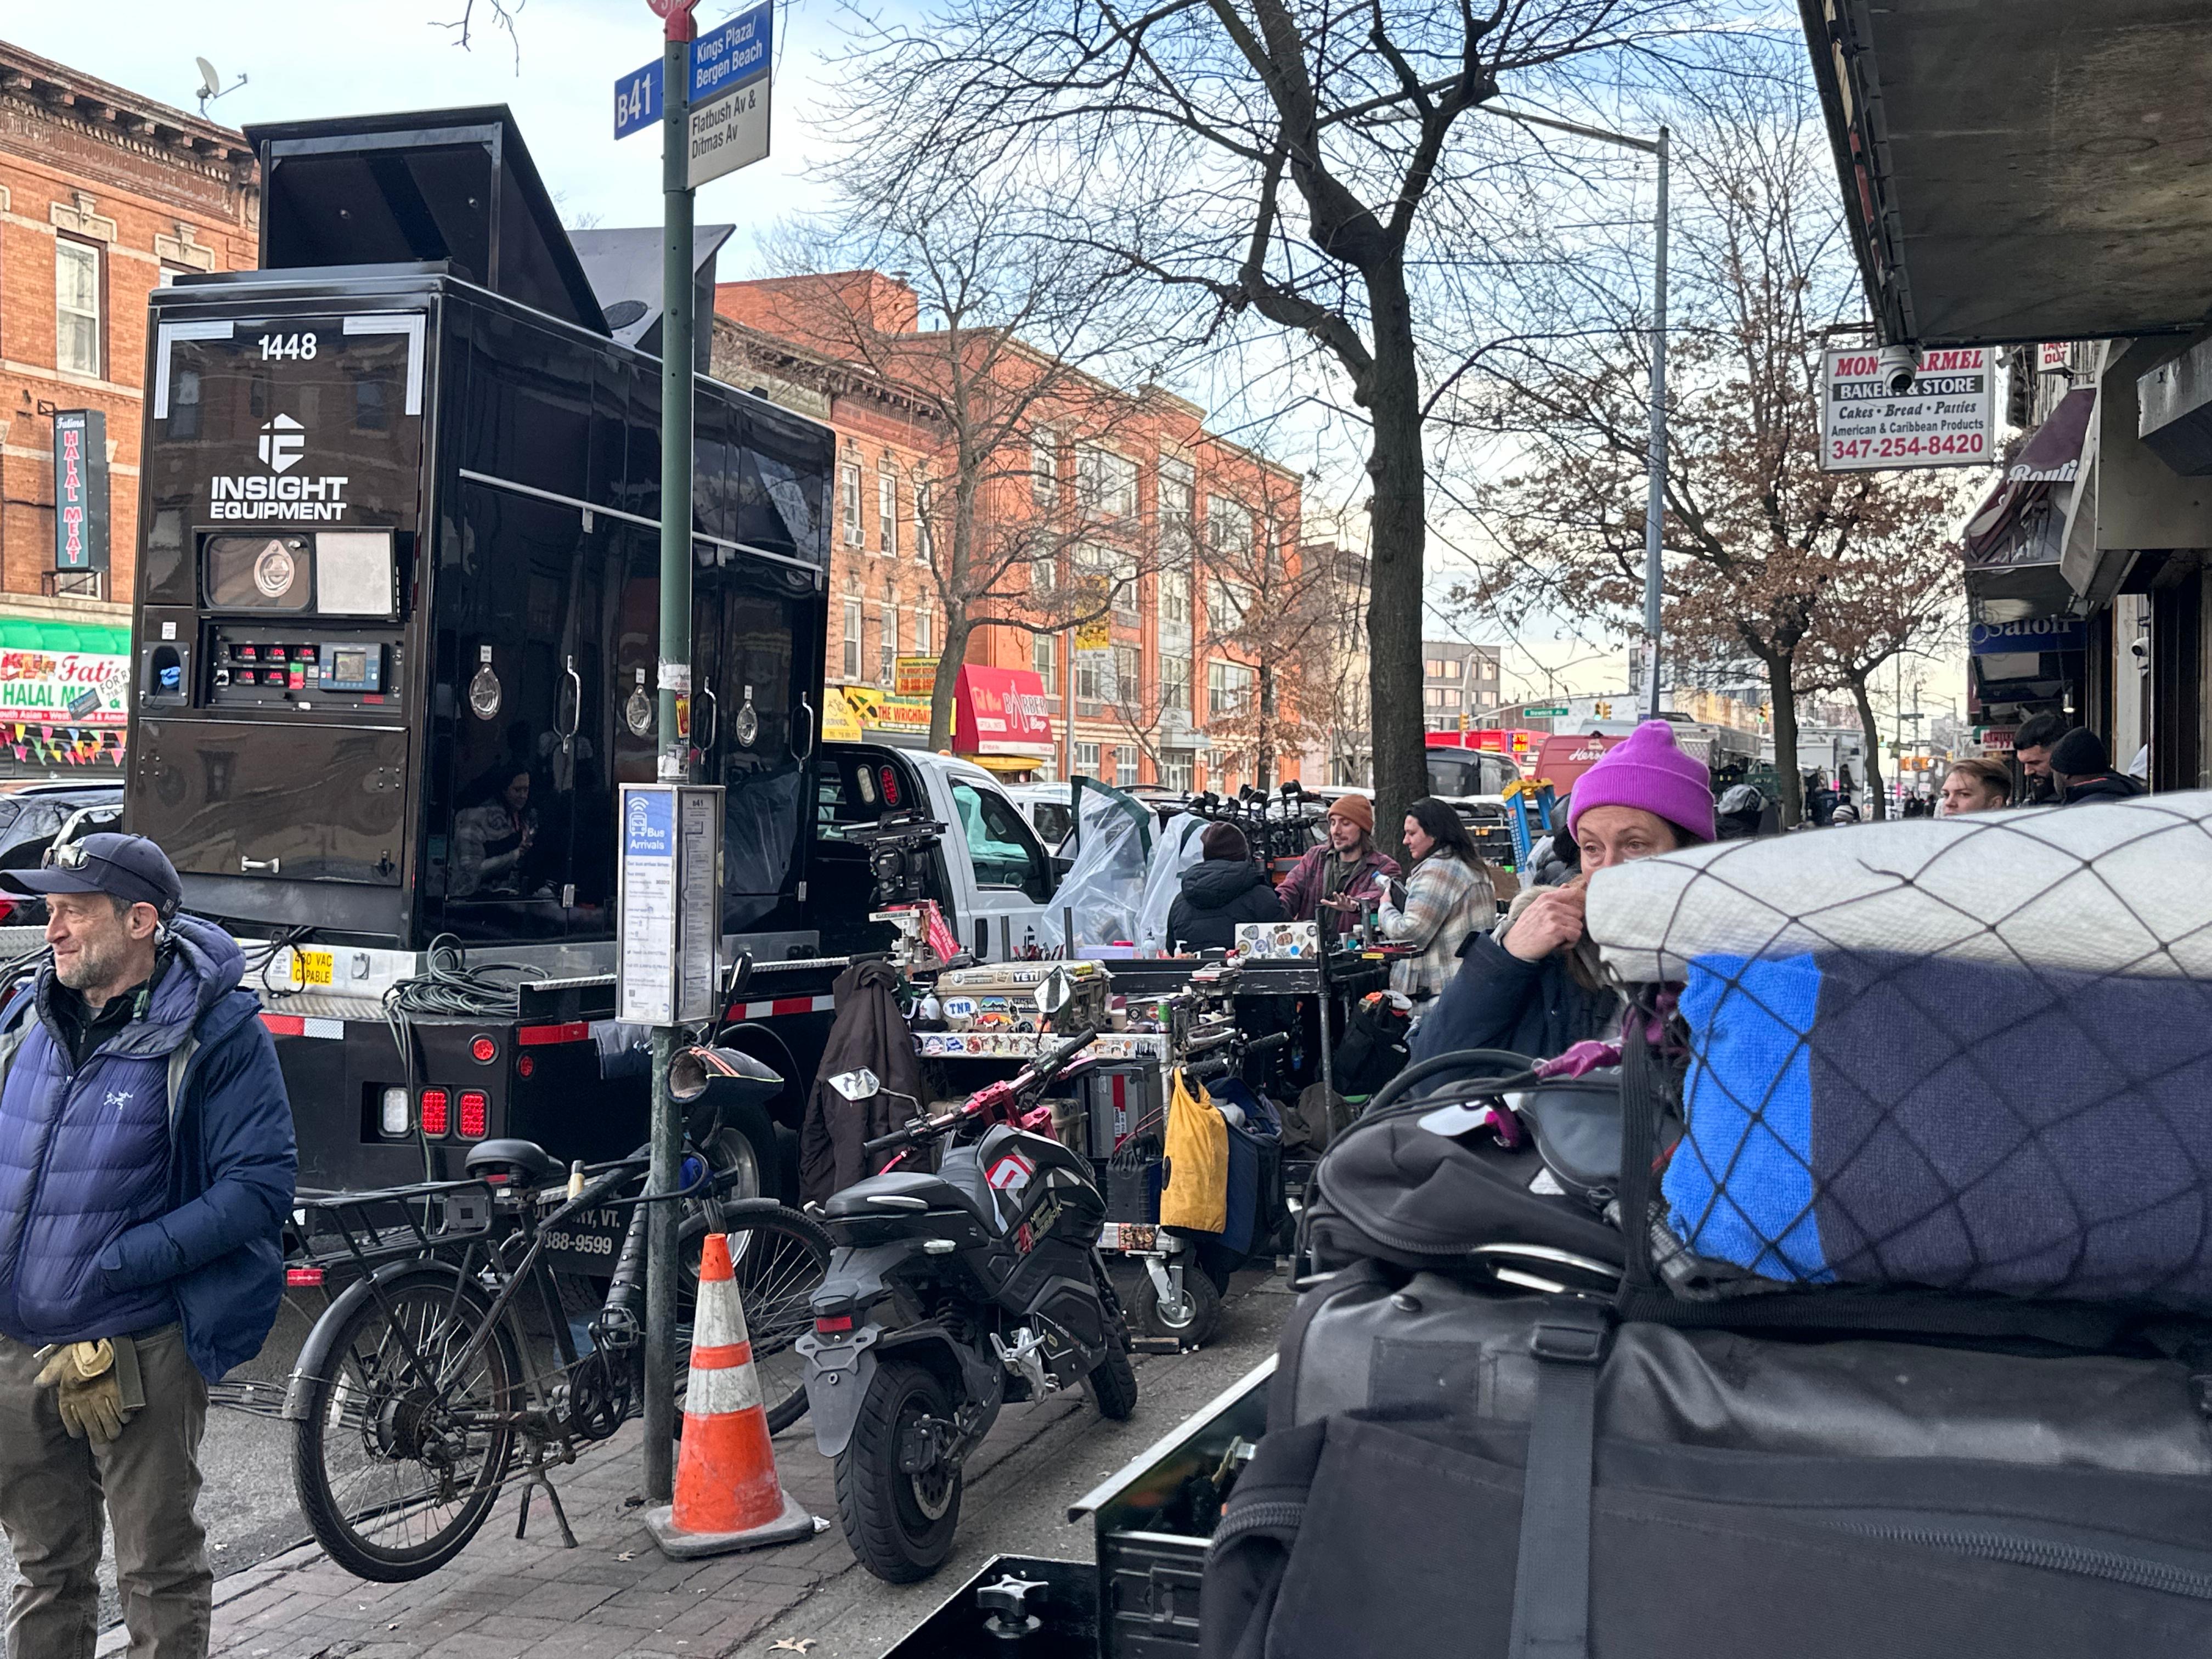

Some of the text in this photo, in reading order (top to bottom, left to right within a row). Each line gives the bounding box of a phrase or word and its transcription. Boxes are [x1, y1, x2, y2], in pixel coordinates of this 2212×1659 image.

[697, 15, 757, 65] Kings Plaza/
[696, 40, 763, 89] Bergen Beach
[618, 72, 651, 128] B41
[692, 89, 757, 136] Flatbush Av &
[692, 124, 738, 159] Ditmas Av
[258, 333, 317, 361] 1448
[1835, 356, 1878, 377] MON
[2045, 351, 2067, 364] OUT
[1922, 377, 1975, 394] STORE
[1839, 400, 1977, 419] Cakes Bread Patties
[1831, 419, 1984, 437] American & Caribbean Products
[1832, 433, 1983, 460] 347-254-8420
[2006, 459, 2079, 484] Bouti
[63, 430, 83, 564] HALAL MEAT
[211, 476, 348, 500] INSIGHT
[210, 502, 347, 521] EQUIPMENT
[3, 684, 54, 707] HALAL
[878, 705, 891, 720] THE
[647, 828, 665, 837] Bus
[630, 839, 665, 850] Arrivals
[317, 953, 332, 967] VAC
[295, 970, 330, 983] CPABLE
[1014, 971, 1039, 981] YETI
[601, 1209, 620, 1228] VT.
